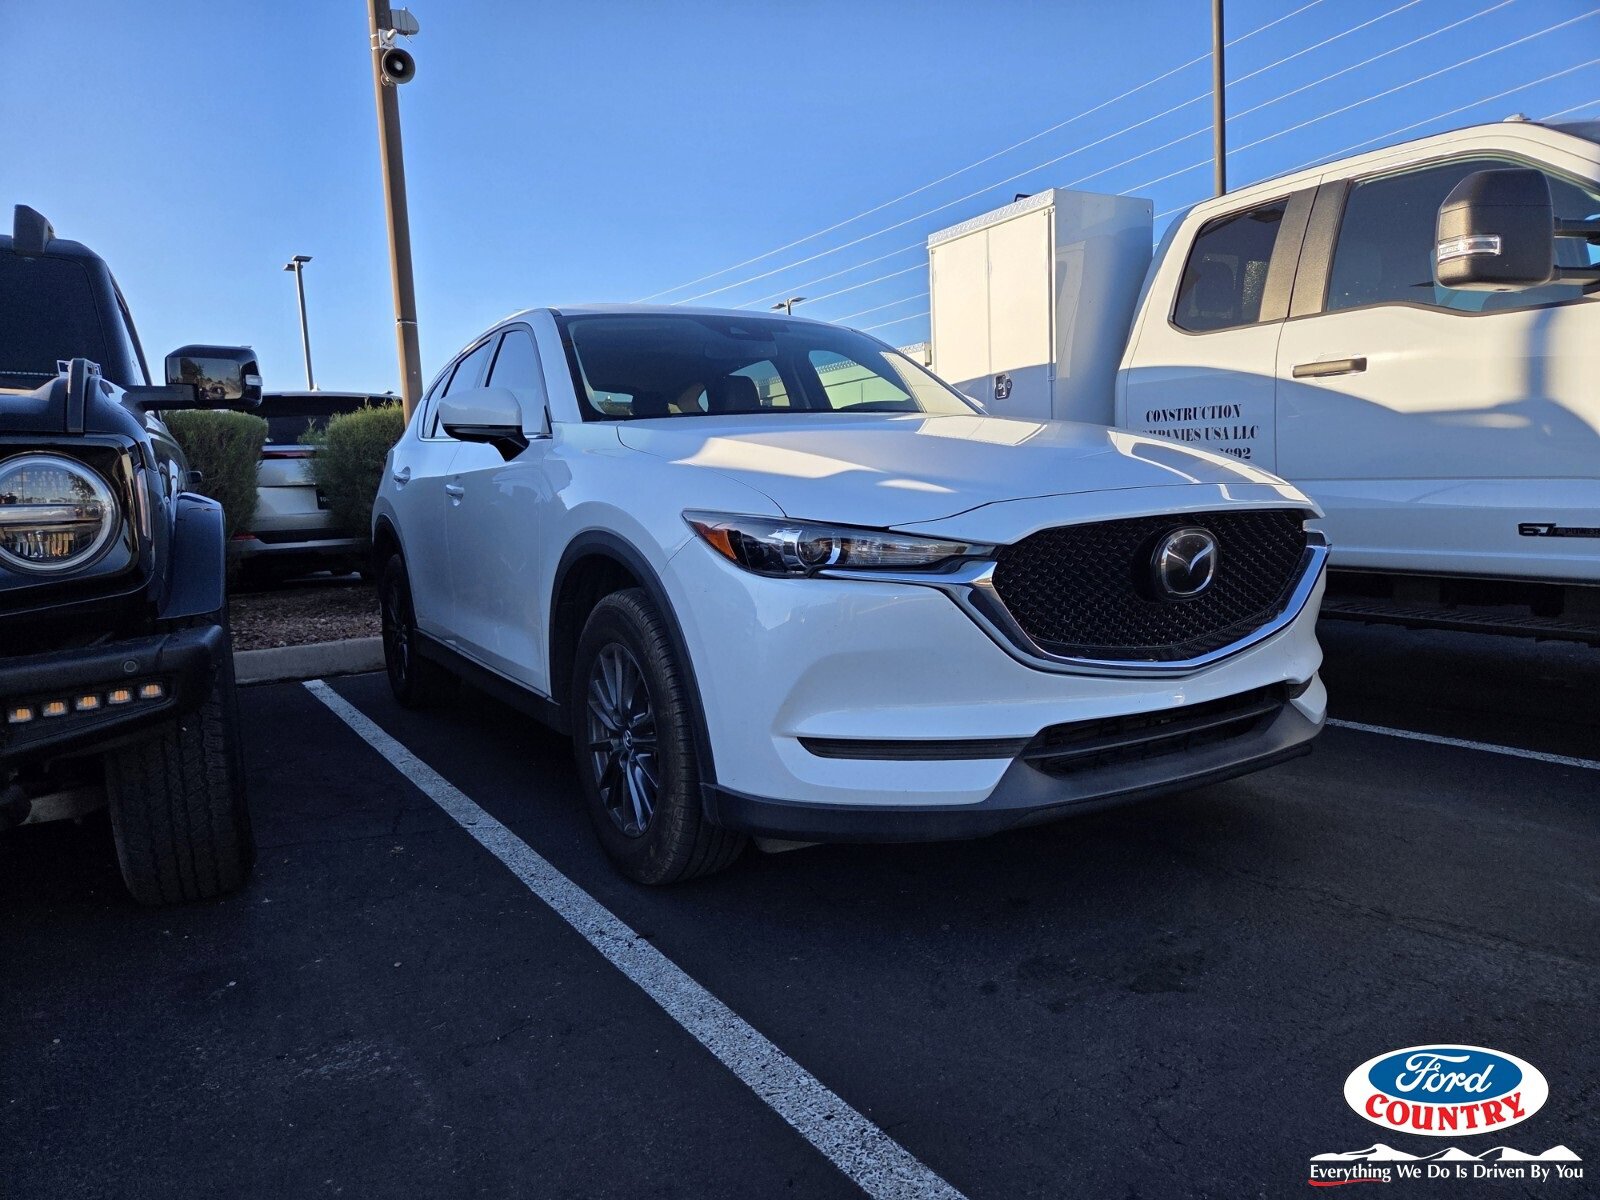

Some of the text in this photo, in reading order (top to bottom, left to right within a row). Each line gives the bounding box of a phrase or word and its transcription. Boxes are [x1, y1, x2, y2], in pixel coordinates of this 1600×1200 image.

[1146, 404, 1241, 422] CONSTRUCTION
[1205, 427, 1229, 440] USA
[1233, 425, 1259, 439] LLC
